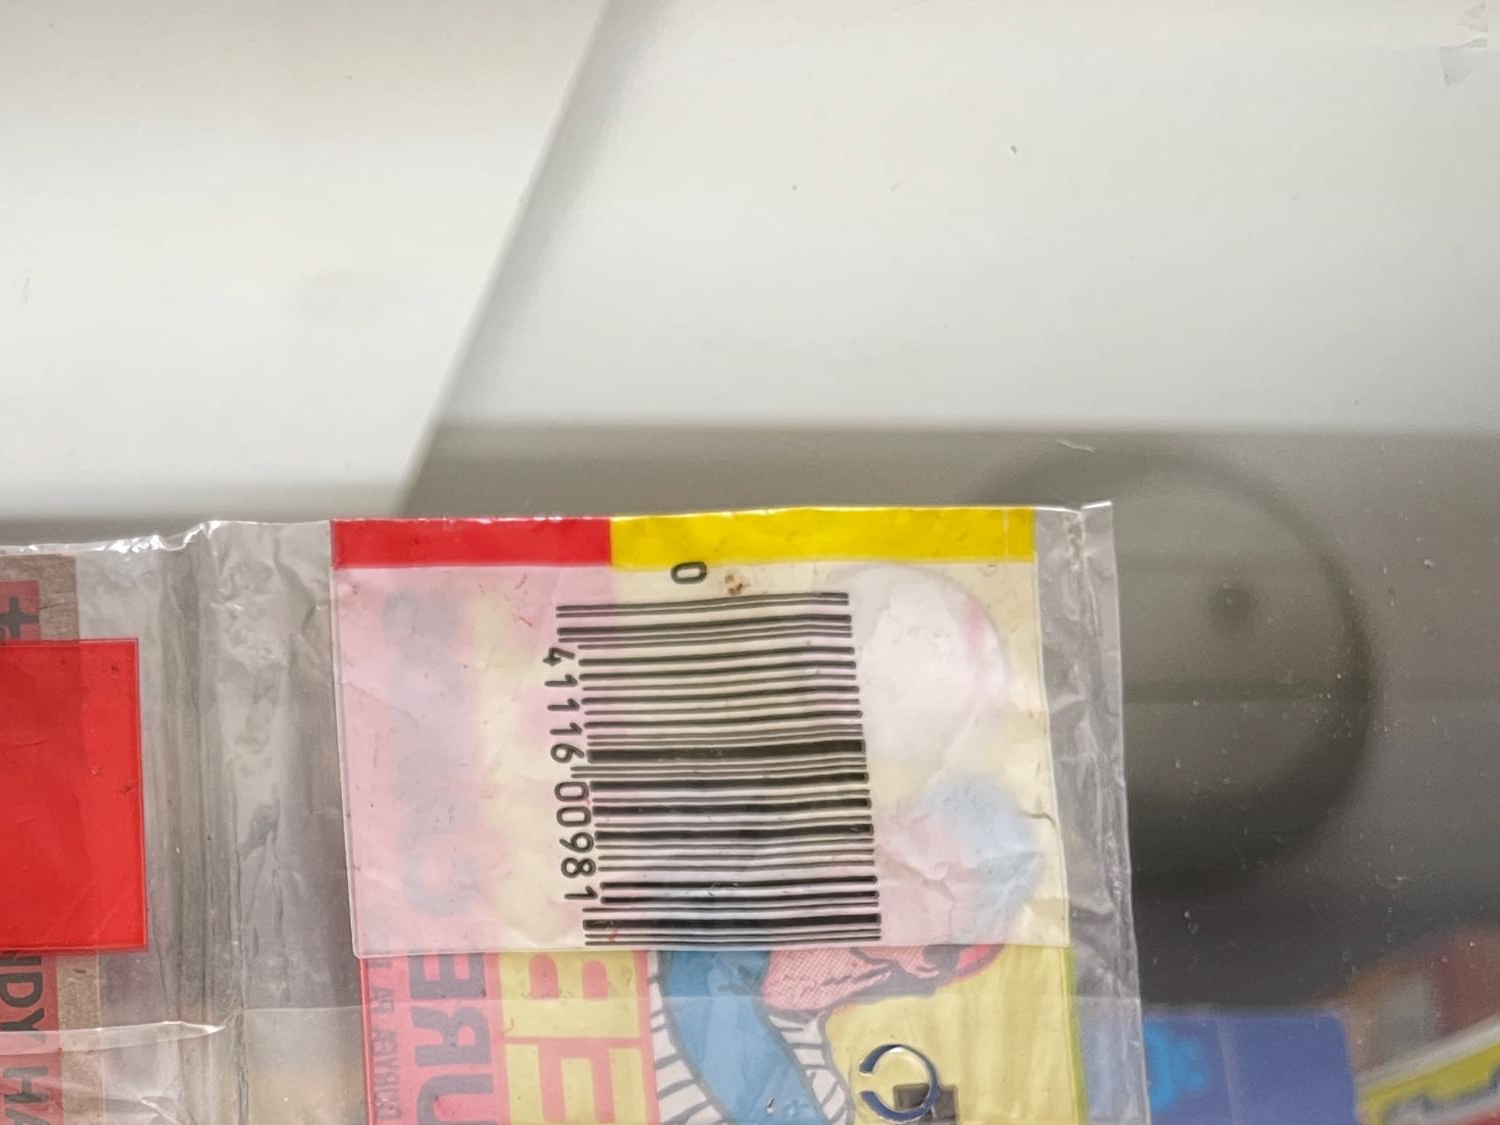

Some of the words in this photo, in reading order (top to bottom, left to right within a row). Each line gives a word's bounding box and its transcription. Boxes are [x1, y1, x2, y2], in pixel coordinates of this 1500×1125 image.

[670, 562, 707, 585] 0
[542, 647, 588, 762] 41116
[554, 781, 600, 901] 00981
